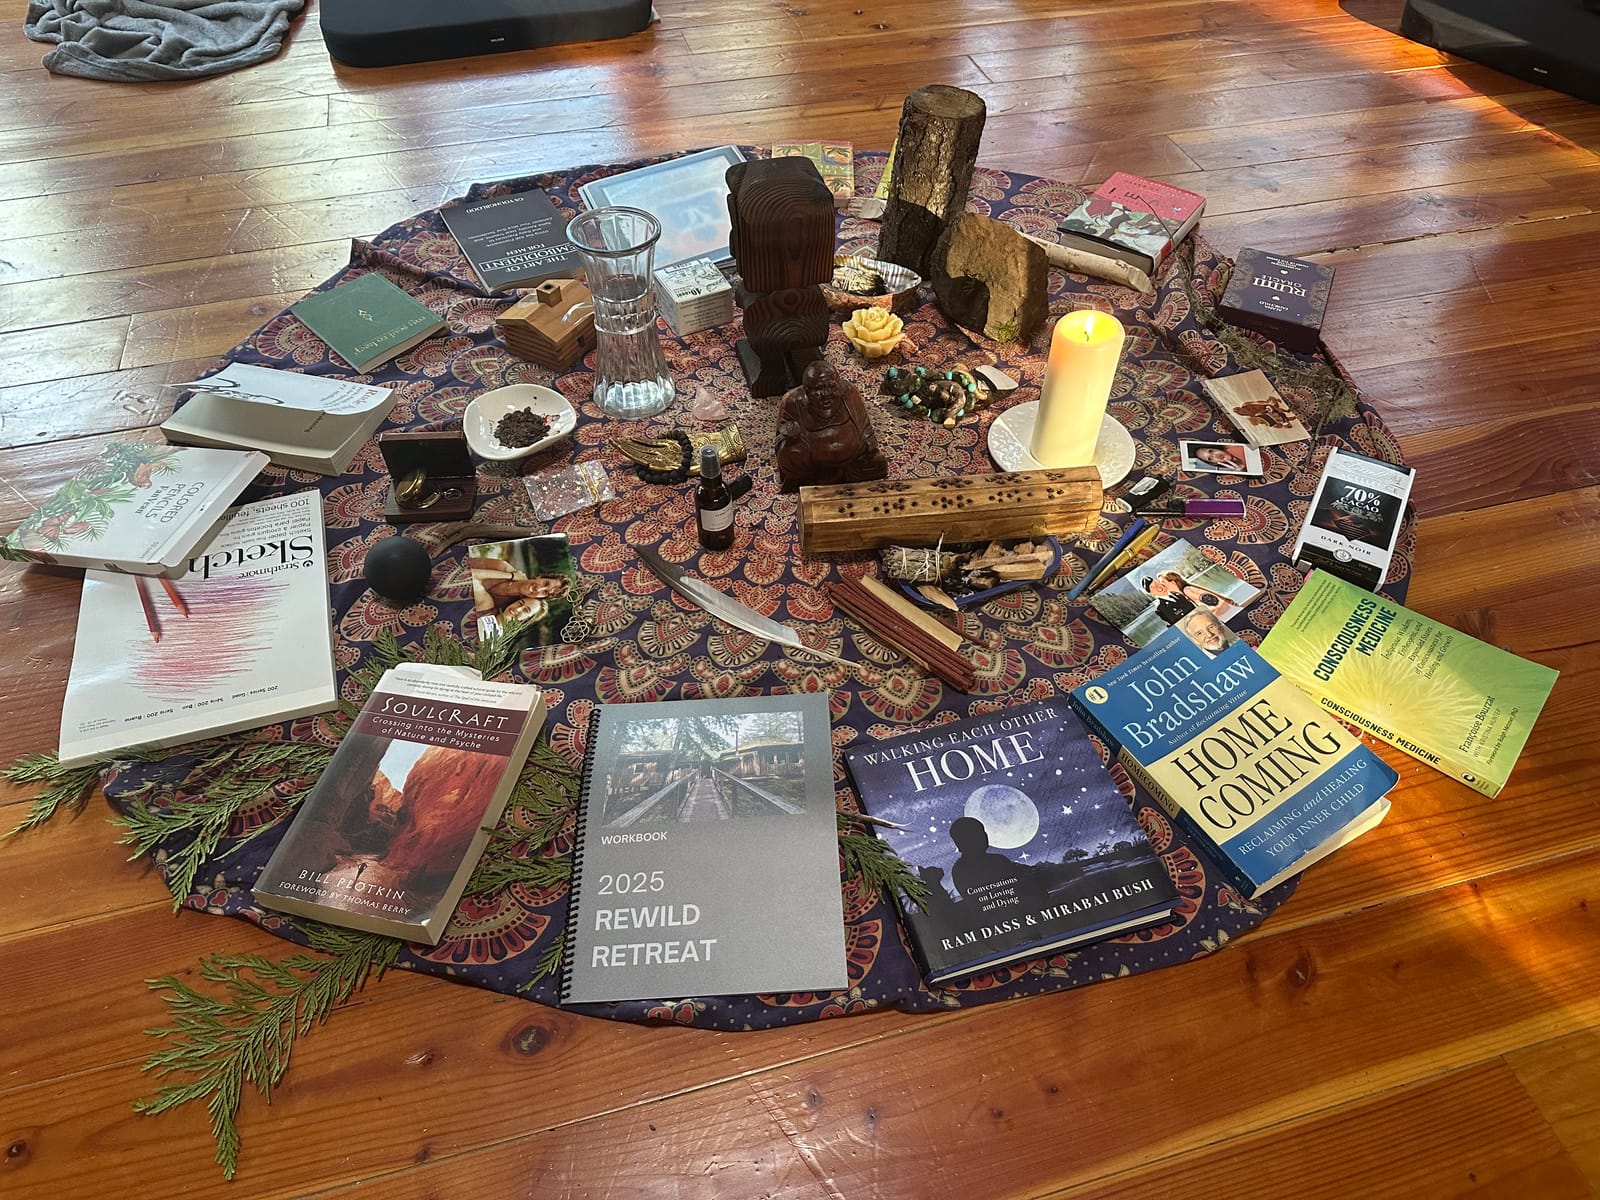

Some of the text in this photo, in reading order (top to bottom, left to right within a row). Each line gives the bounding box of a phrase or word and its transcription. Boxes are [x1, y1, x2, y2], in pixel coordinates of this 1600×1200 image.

[482, 243, 575, 270] EMBODIMENT
[504, 253, 567, 272] THE ART OF
[505, 242, 544, 255] FOR MEN
[1262, 274, 1301, 287] ORACLE
[145, 483, 187, 518] PENCILS
[160, 482, 205, 523] COLORED
[252, 502, 288, 514] sheets,
[290, 498, 309, 508] 100
[1339, 497, 1379, 513] CACAO
[1341, 484, 1381, 507] 70%
[189, 535, 313, 580] Sketch
[1320, 535, 1371, 555] DARK NOIR
[238, 560, 300, 579] Strathmore
[1312, 596, 1376, 681] CONSCIOUSNESS
[1355, 605, 1396, 656] MEDICINE
[249, 687, 266, 696] Series
[266, 684, 278, 692] 200
[1088, 688, 1106, 702] #1
[1127, 656, 1202, 712] John
[145, 710, 158, 718] 200
[382, 696, 509, 729] SOULCRAFT
[1123, 656, 1256, 749] Bradshaw
[372, 716, 500, 742] Crossing into the Mysteries
[1167, 728, 1188, 746] Author
[1194, 701, 1229, 727] Reclaiming
[1227, 688, 1247, 705] Virtue
[1319, 695, 1441, 765] CONSCIOUSNESS MEDICINE
[1458, 719, 1482, 753] Françoise
[1475, 694, 1495, 721] Bourzat
[382, 726, 481, 750] of Nature and Psyche
[863, 708, 1058, 767] WALKING EACH OTHER
[1171, 699, 1293, 791] HOME
[903, 730, 1045, 792] HOME
[1199, 721, 1341, 829] COMING
[1119, 752, 1176, 812] HOMECOMING
[1238, 806, 1301, 856] RECLAIMING
[1300, 790, 1322, 812] and
[1320, 757, 1367, 796] HEALING
[1266, 830, 1298, 857] YOUR
[1296, 806, 1331, 835] INNER
[1329, 781, 1364, 812] CHILD
[601, 831, 668, 845] WORKBOOK
[298, 870, 406, 900] BILL PLOTKIN
[598, 870, 665, 896] 2025
[967, 876, 1018, 896] Conversations
[978, 886, 1015, 903] on Loving
[279, 881, 411, 915] FOREWORD BY THOMAS BERRY
[981, 895, 1019, 912] and Dying
[595, 904, 700, 931] REWILD
[941, 878, 1154, 951] RAM DASS & MIRABAI BUSH
[591, 939, 717, 968] RETREAT
